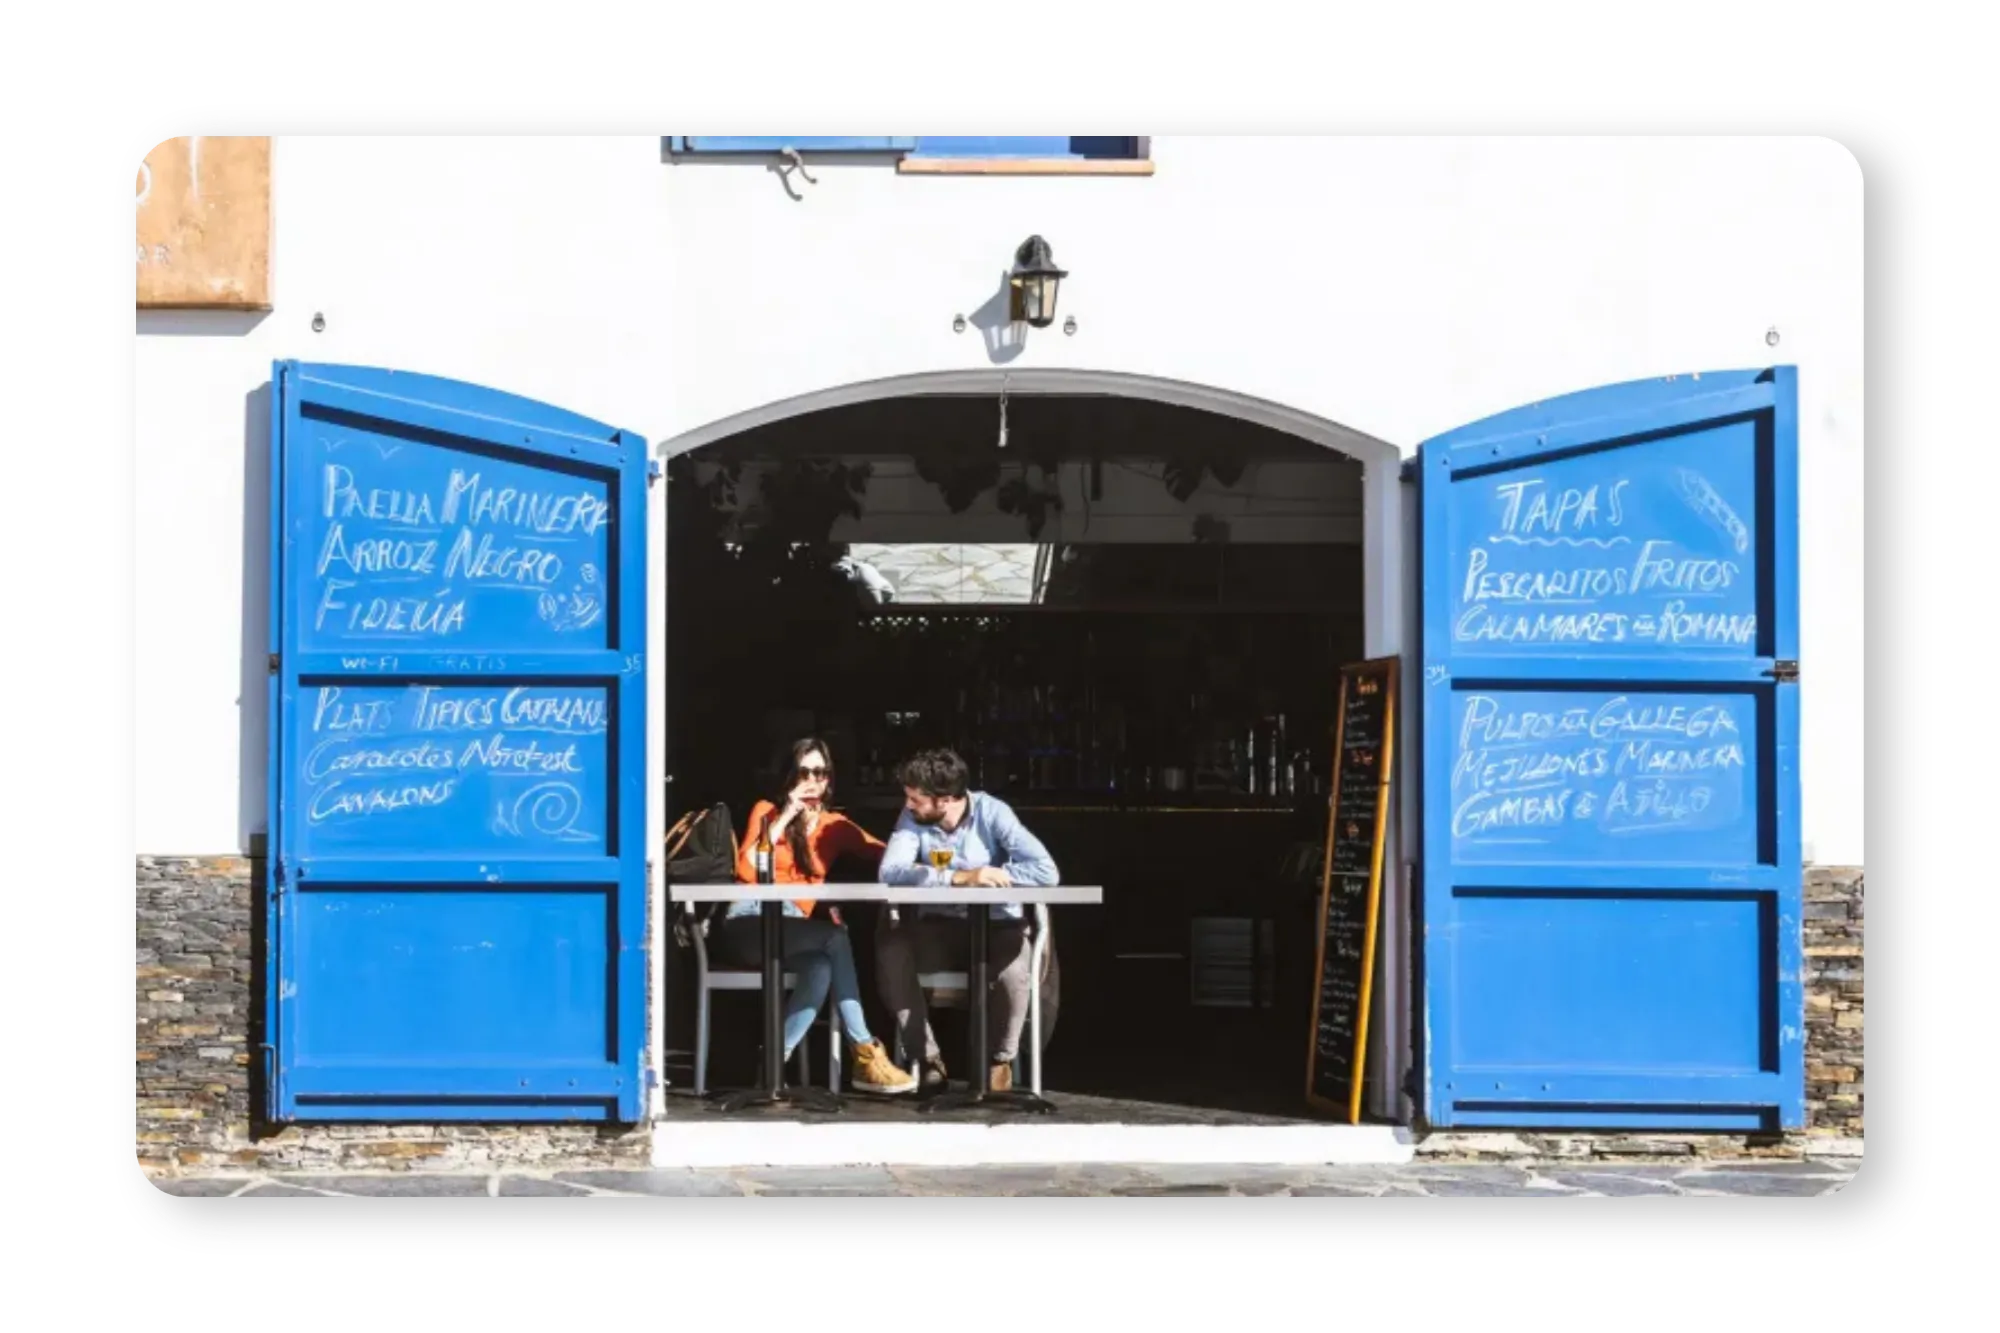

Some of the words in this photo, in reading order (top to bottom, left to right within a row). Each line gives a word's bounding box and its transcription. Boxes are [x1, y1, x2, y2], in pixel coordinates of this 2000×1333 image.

[322, 463, 436, 526] PAELLA
[1496, 479, 1629, 534] TAPAS
[316, 520, 438, 575] ARROZ
[444, 525, 563, 583] NEGRO
[1630, 540, 1740, 595] FRITOS
[1456, 603, 1629, 643] CALAMARES
[312, 686, 394, 733] PLATS
[1459, 696, 1555, 751] PULPO
[1590, 696, 1739, 738] GALLEGA
[1452, 788, 1574, 838] GAMBAS
